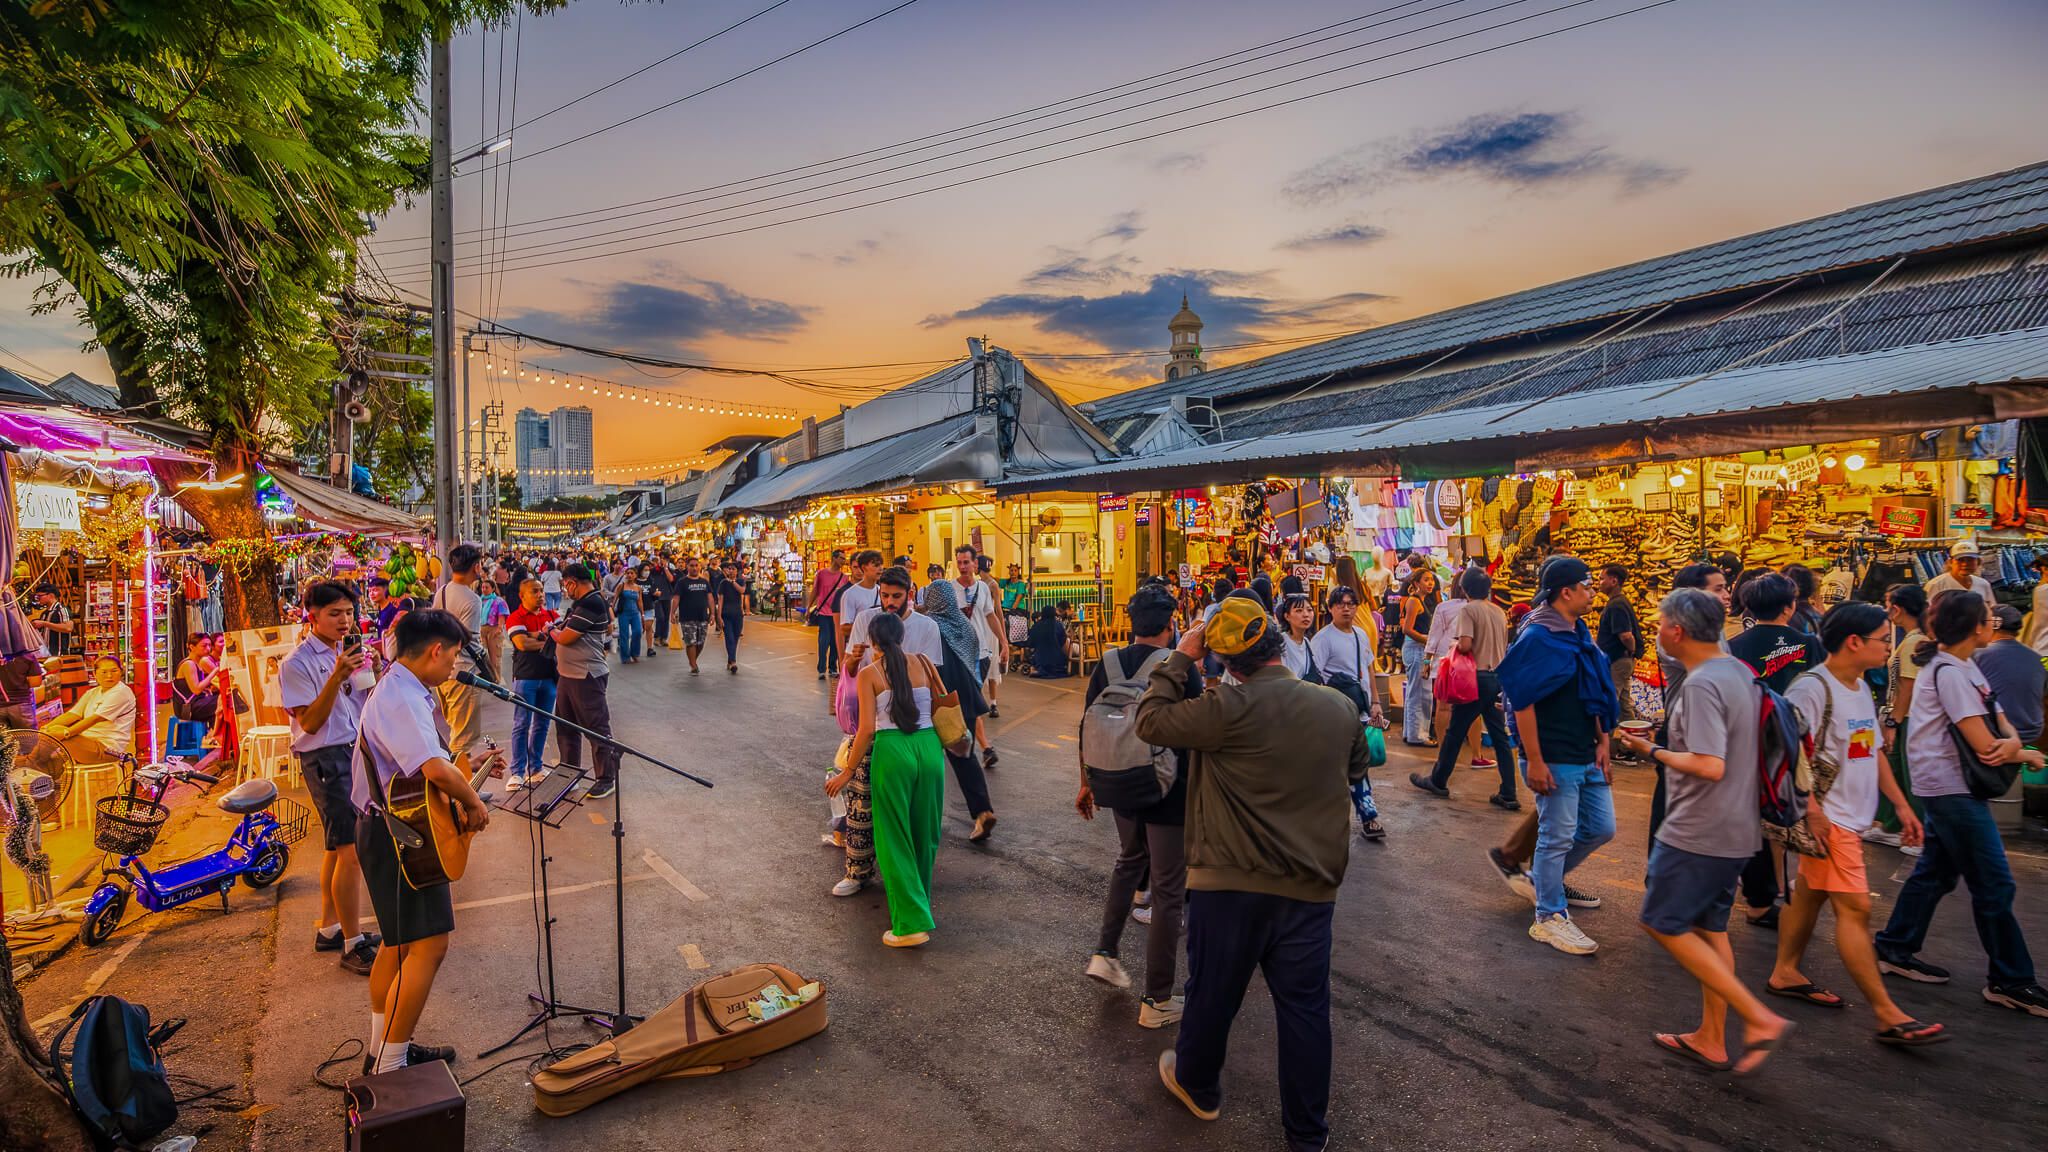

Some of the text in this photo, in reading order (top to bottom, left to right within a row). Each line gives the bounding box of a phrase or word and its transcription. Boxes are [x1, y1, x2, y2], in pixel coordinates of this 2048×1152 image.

[1750, 469, 1776, 481] SALE
[1787, 457, 1815, 475] 280
[1536, 476, 1557, 494] 350
[1595, 475, 1619, 493] 350
[161, 886, 203, 906] ULTRA
